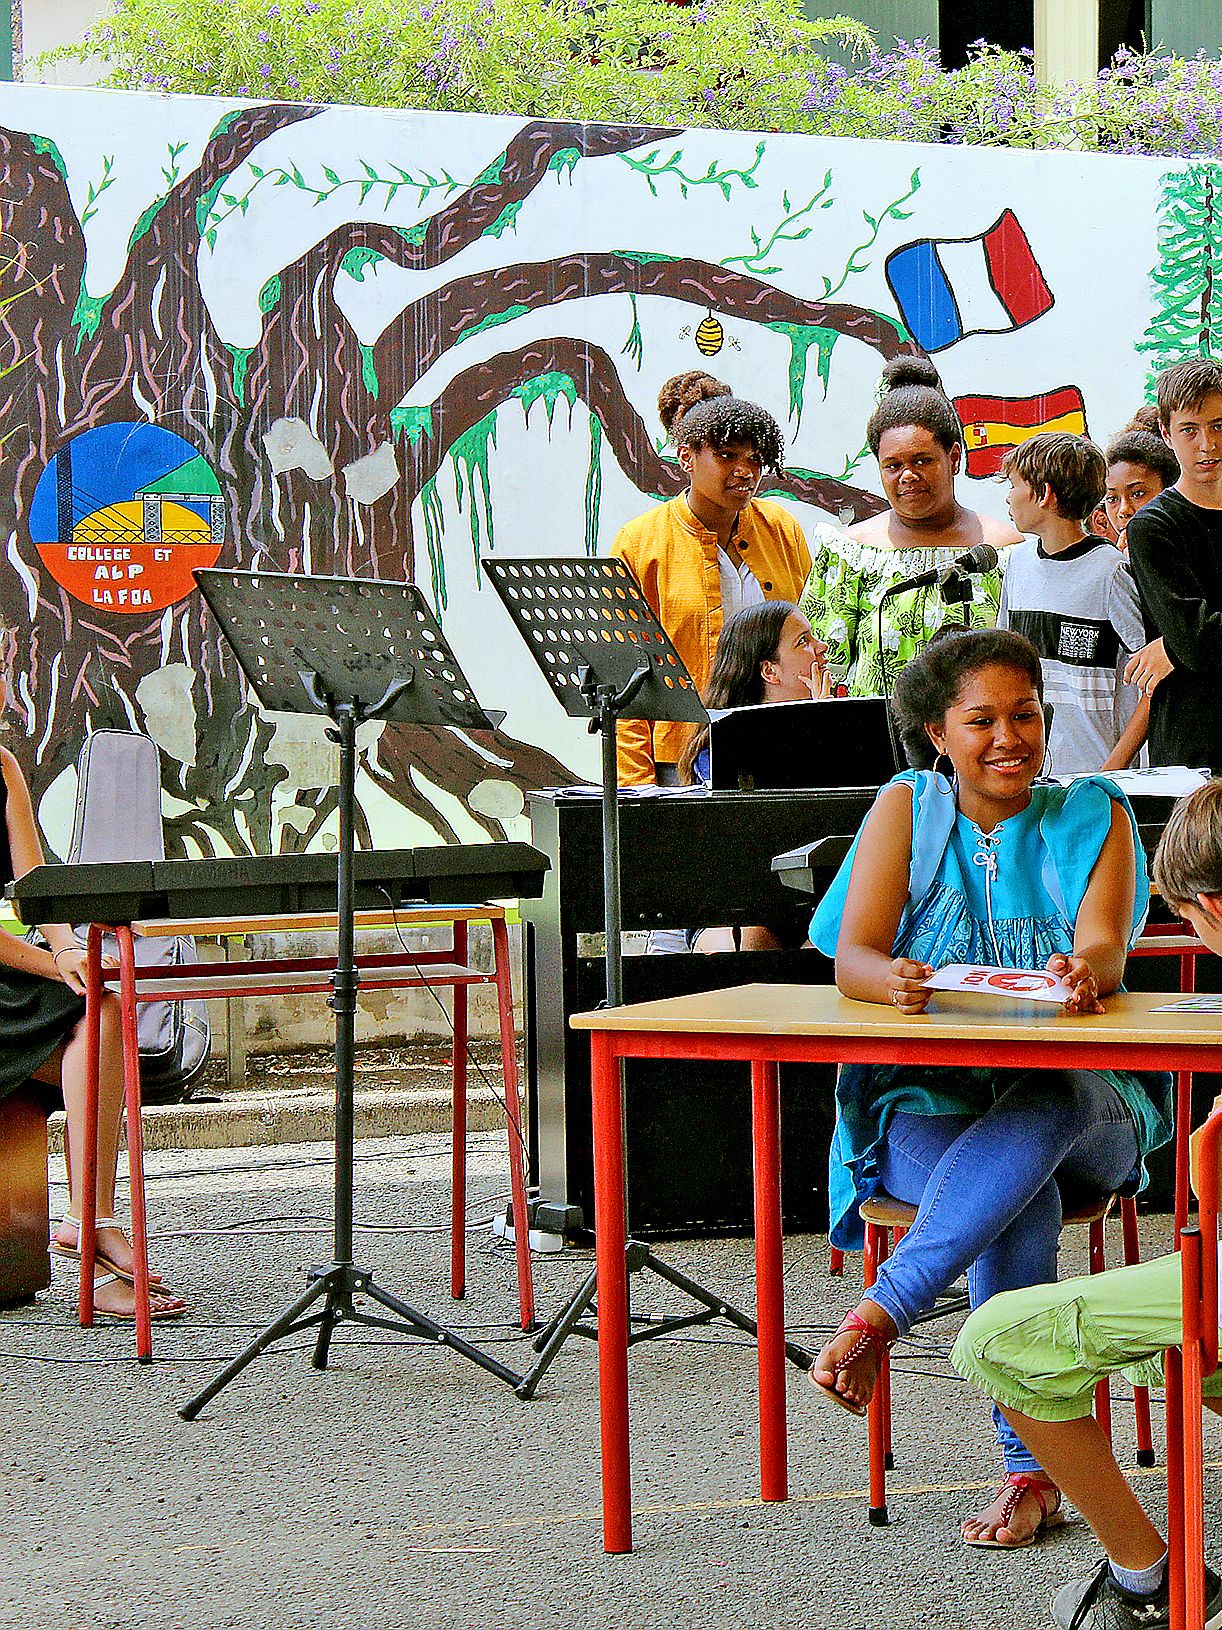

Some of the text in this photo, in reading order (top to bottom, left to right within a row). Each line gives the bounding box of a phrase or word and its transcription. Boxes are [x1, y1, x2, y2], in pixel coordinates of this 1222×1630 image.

[67, 546, 172, 561] COLLEGE ET
[92, 588, 152, 605] LA FOA
